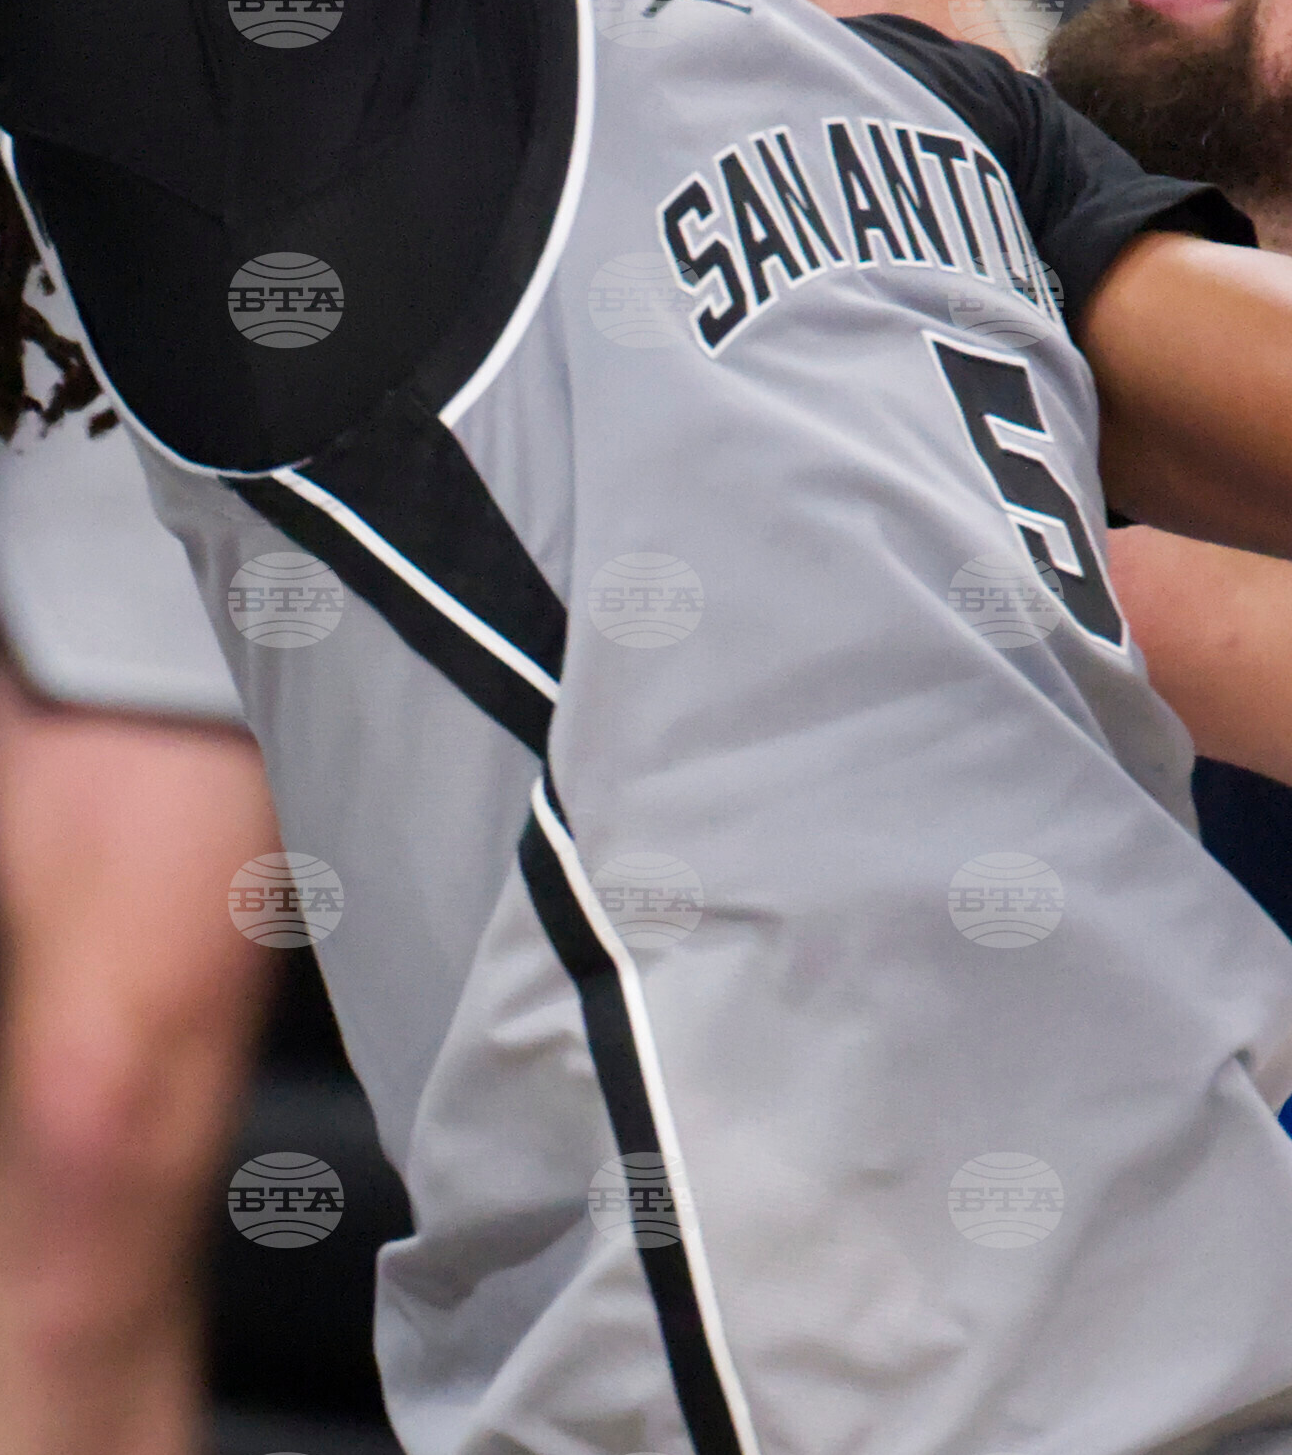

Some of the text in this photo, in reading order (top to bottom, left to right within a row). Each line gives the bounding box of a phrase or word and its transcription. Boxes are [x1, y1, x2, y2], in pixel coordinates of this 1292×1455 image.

[656, 117, 1058, 359] SAN ANTO
[921, 328, 1130, 657] 5
